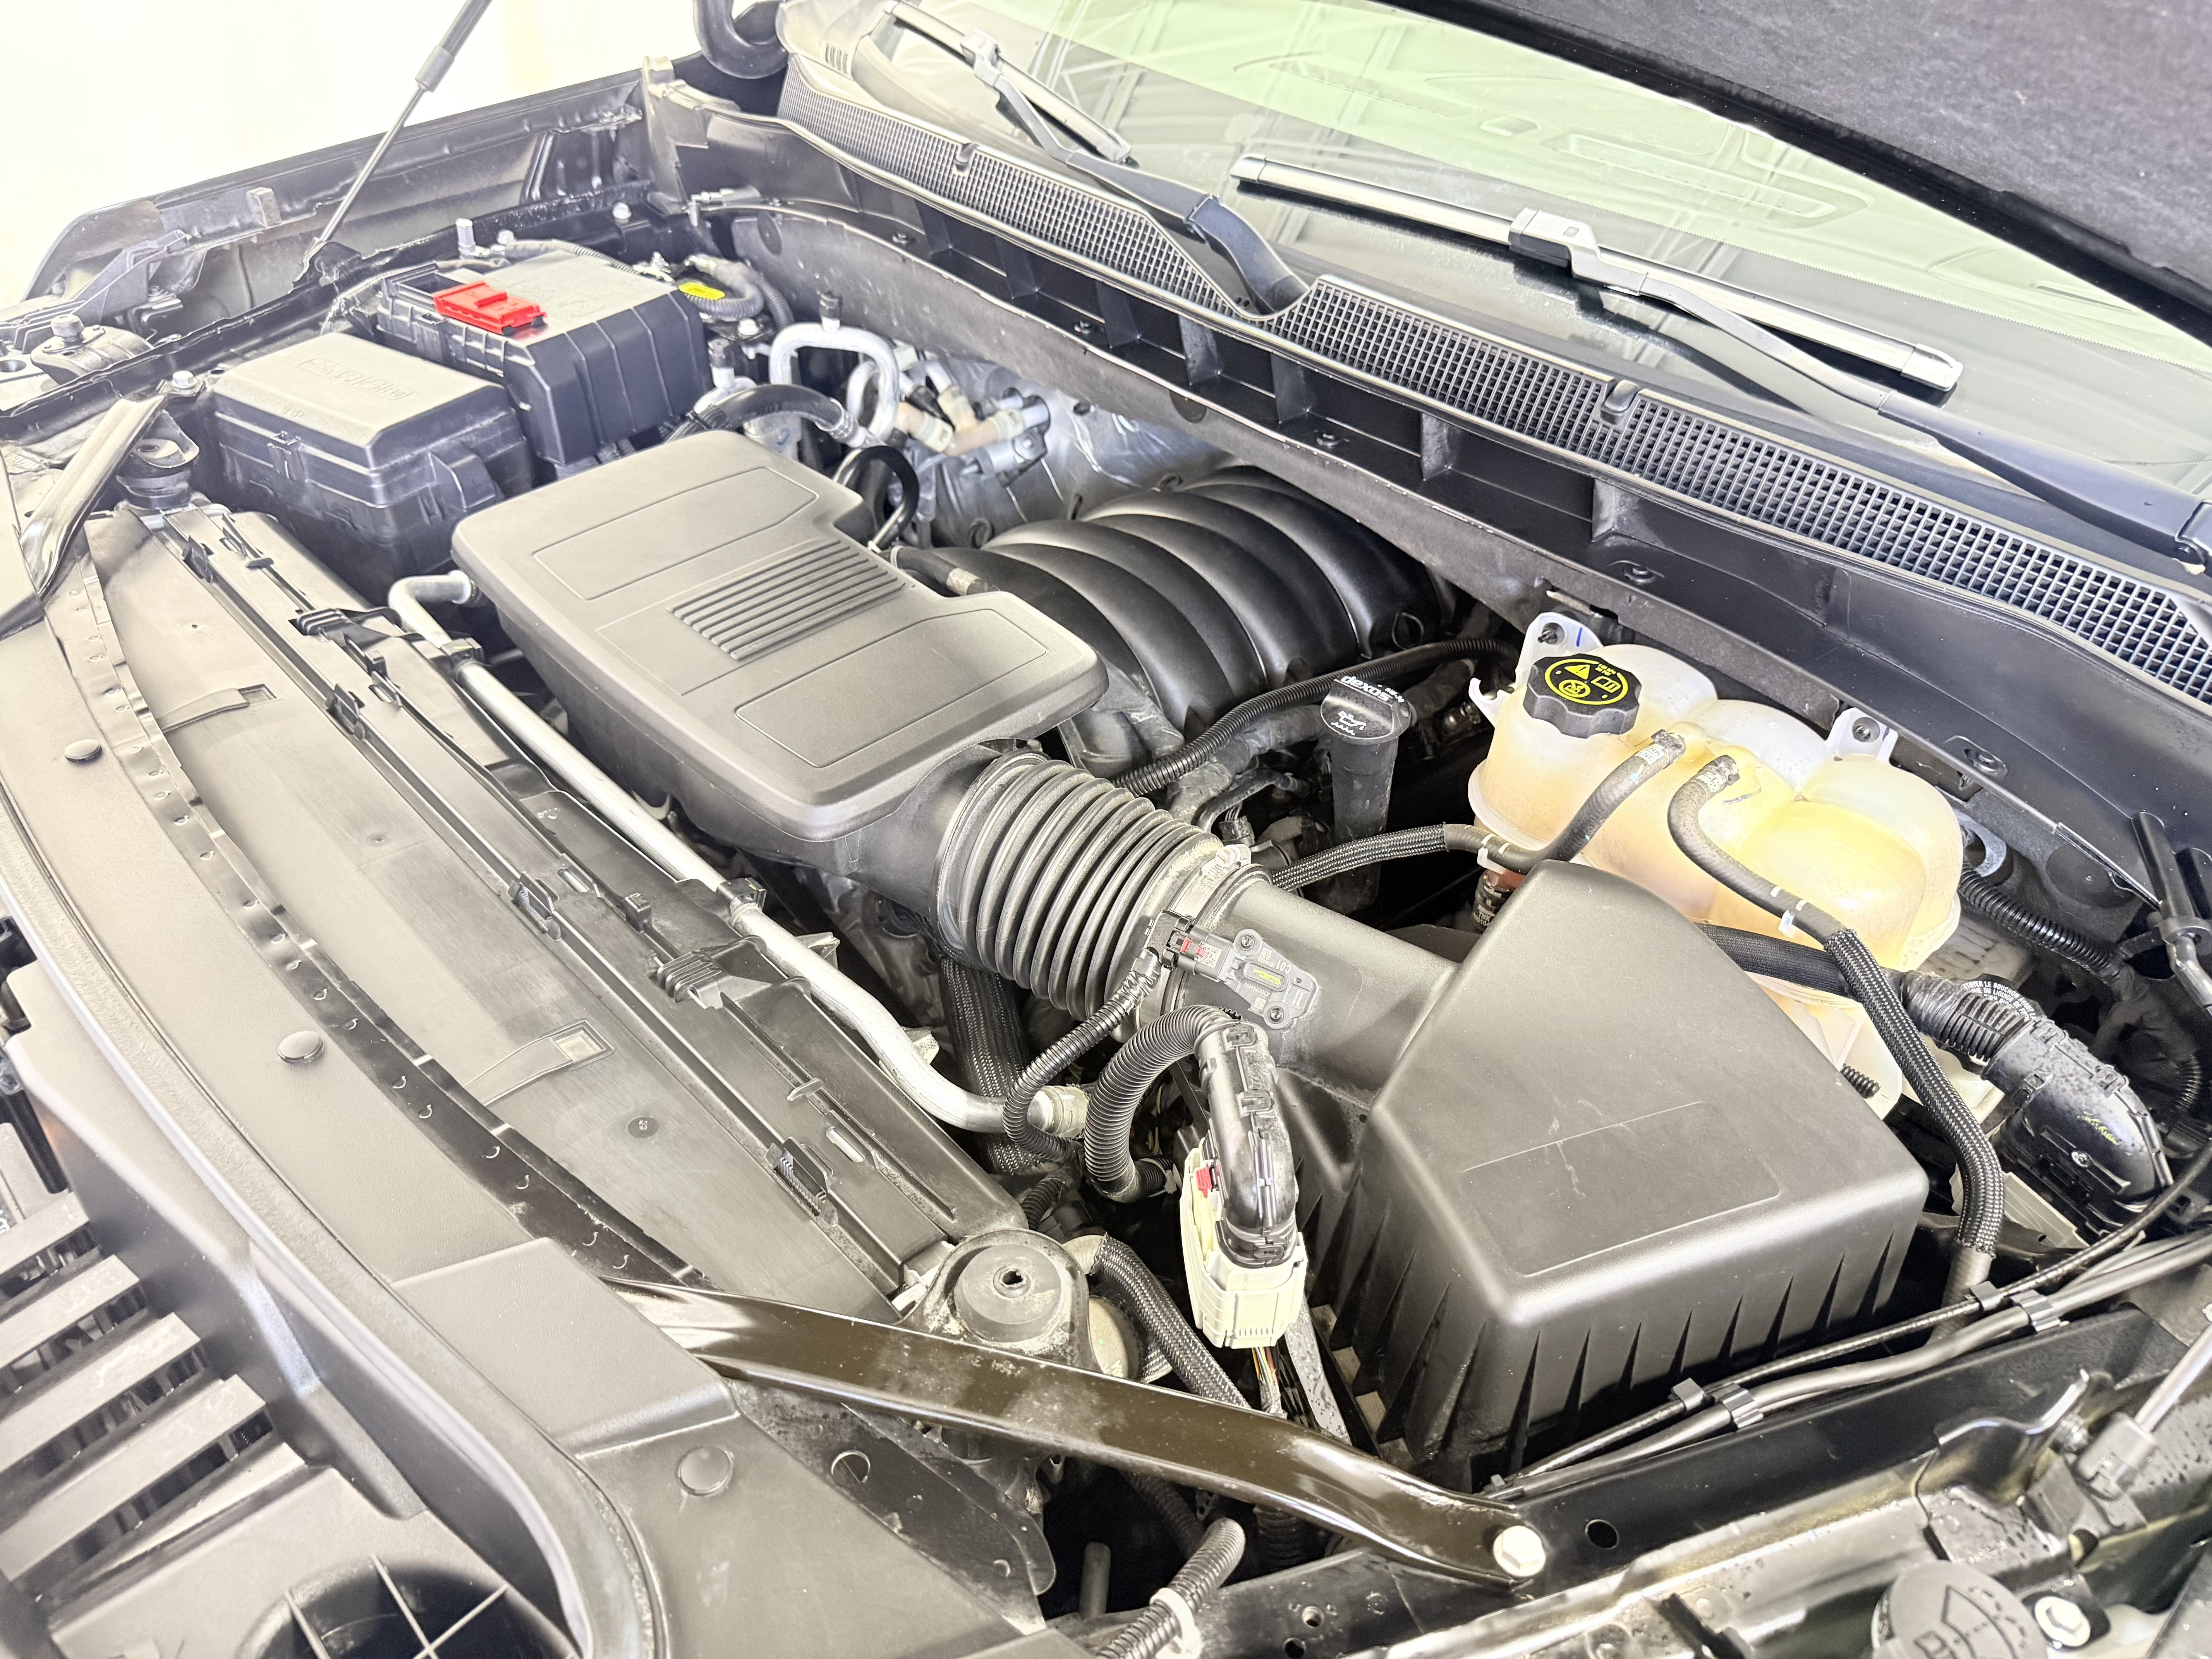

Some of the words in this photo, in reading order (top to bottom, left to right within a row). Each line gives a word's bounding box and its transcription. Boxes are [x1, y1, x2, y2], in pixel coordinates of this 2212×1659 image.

[1340, 676, 1389, 701] dexos
[1638, 751, 1653, 762] ENG
[1993, 989, 2014, 1003] LIQUIDE
[1993, 982, 2020, 999] BOUCHON
[2018, 997, 2036, 1012] AVANT
